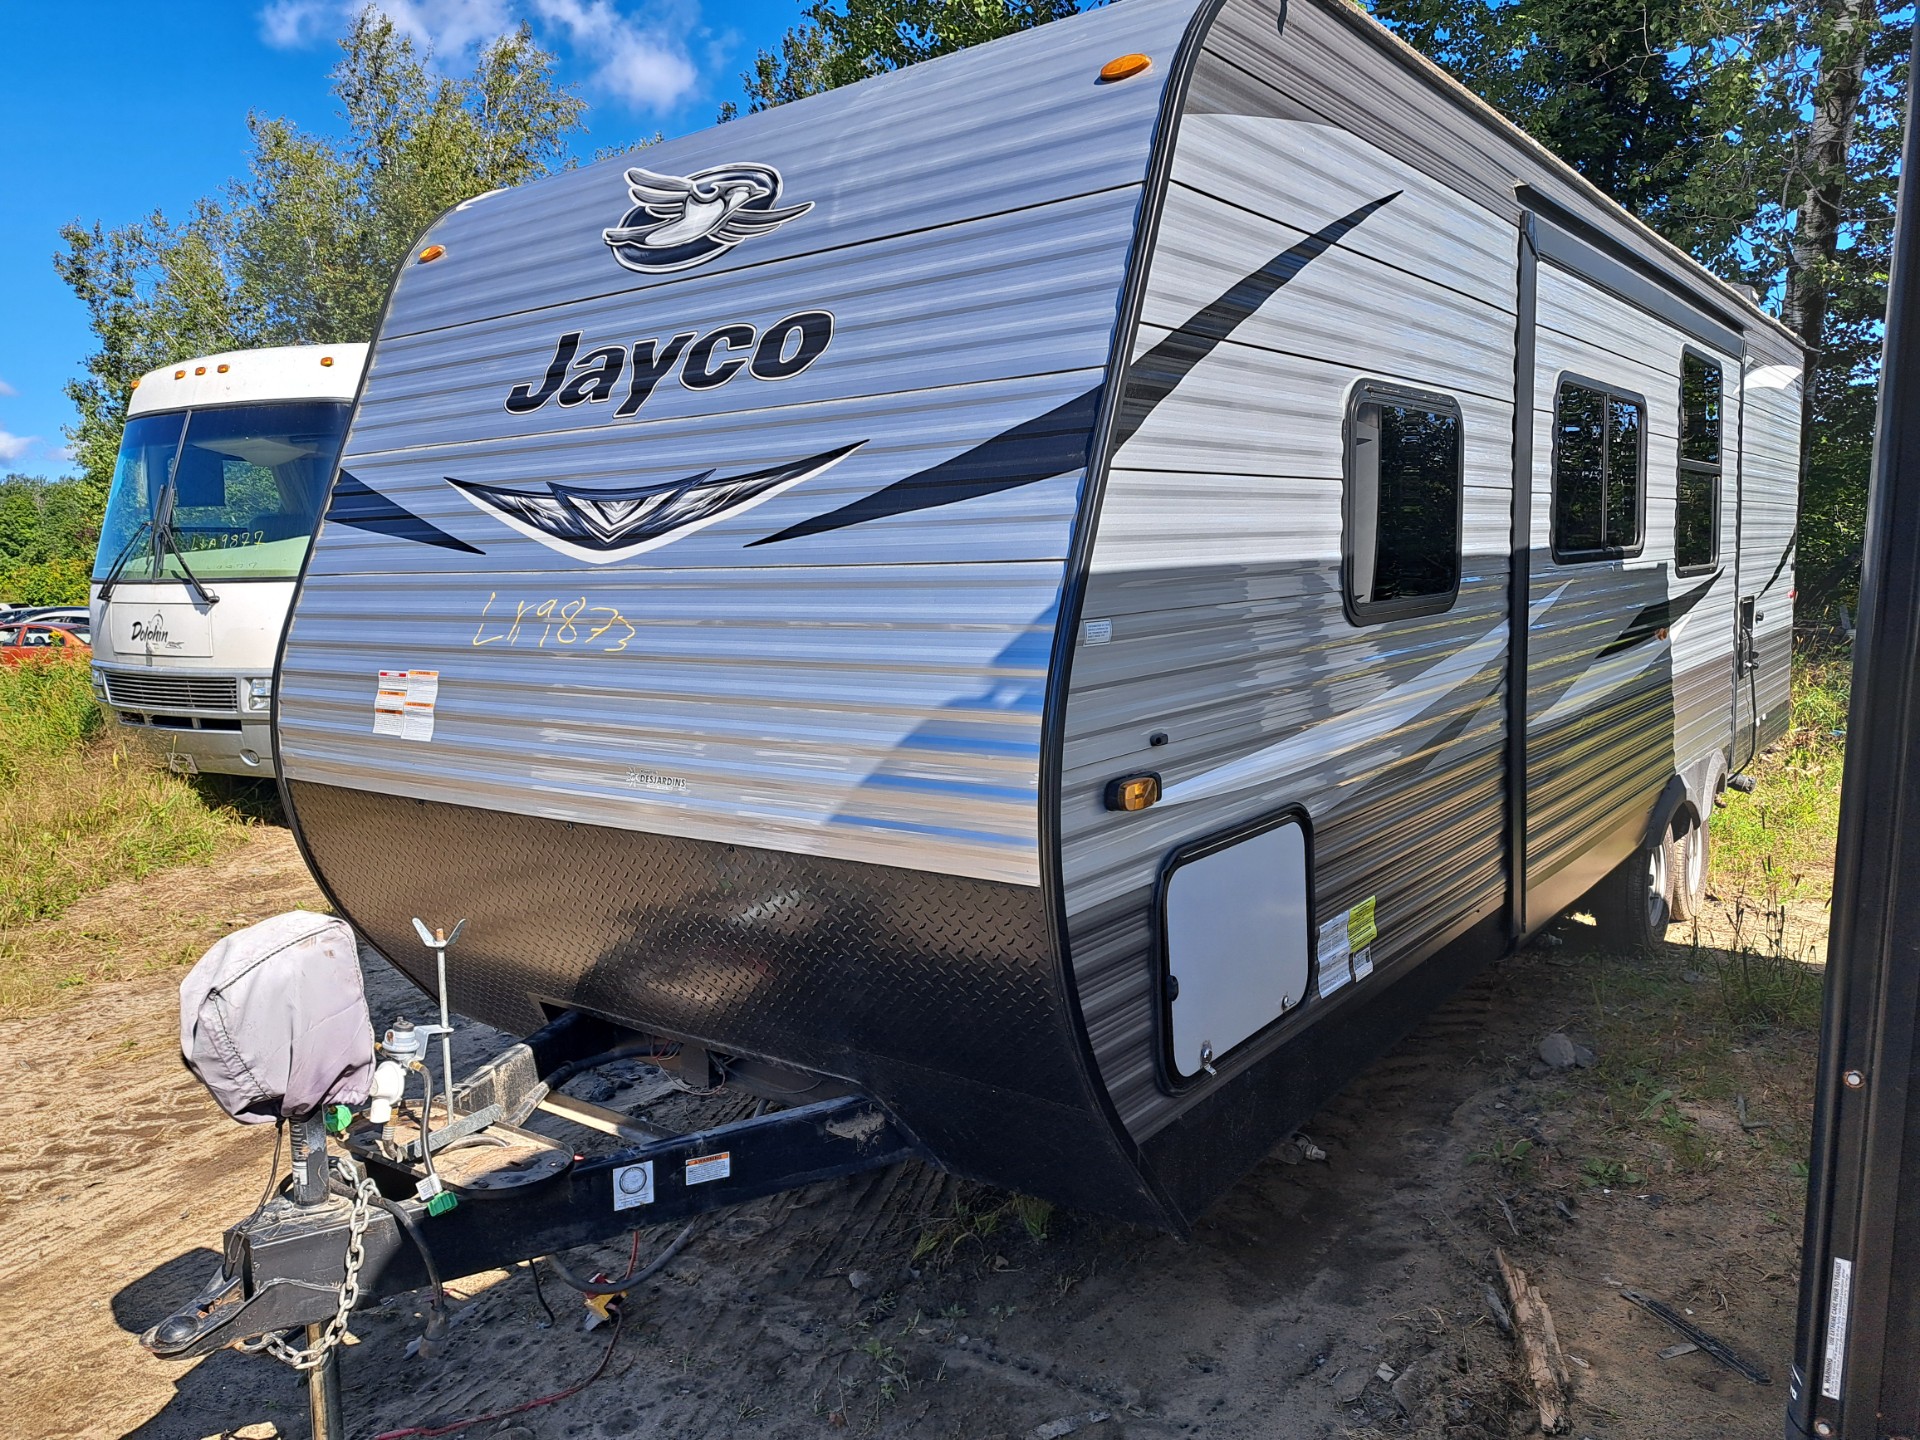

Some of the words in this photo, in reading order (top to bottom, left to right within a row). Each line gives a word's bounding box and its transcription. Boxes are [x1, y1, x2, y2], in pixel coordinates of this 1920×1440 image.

[504, 310, 835, 419] Jayco
[131, 621, 169, 643] Dolphin
[640, 774, 687, 787] DESJARDINS
